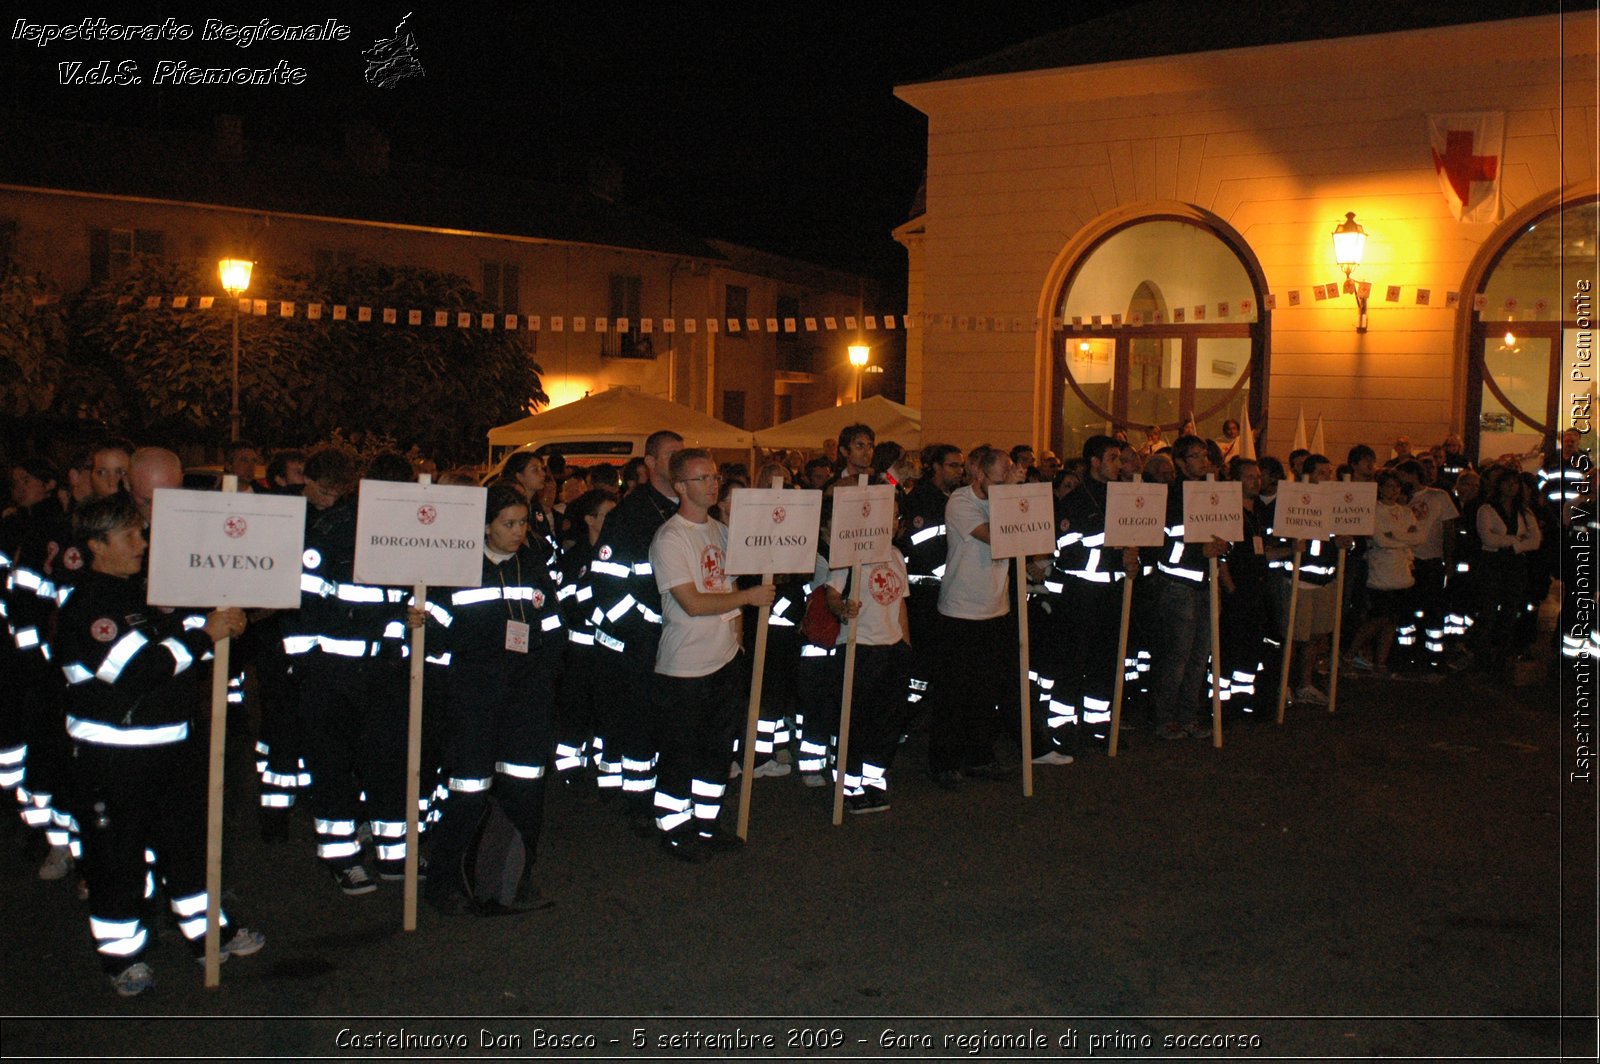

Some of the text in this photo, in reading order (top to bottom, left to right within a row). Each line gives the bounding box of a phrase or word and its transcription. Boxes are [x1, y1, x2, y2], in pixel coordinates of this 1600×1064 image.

[1287, 507, 1322, 516] SETTIMO
[1332, 506, 1370, 514] LLANOVA
[1118, 517, 1158, 527] OLEGGIO
[1189, 513, 1240, 523] SAVIGLIANO
[1285, 517, 1323, 528] TORINESE
[1334, 516, 1361, 524] D'ASTI
[839, 527, 890, 540] GRAVELLONA
[1000, 521, 1051, 535] MONCALVO
[370, 534, 476, 550] BORGOMANERO
[744, 535, 808, 547] CHIVASSO
[853, 541, 875, 552] TOCE
[189, 553, 274, 571] BAVENO
